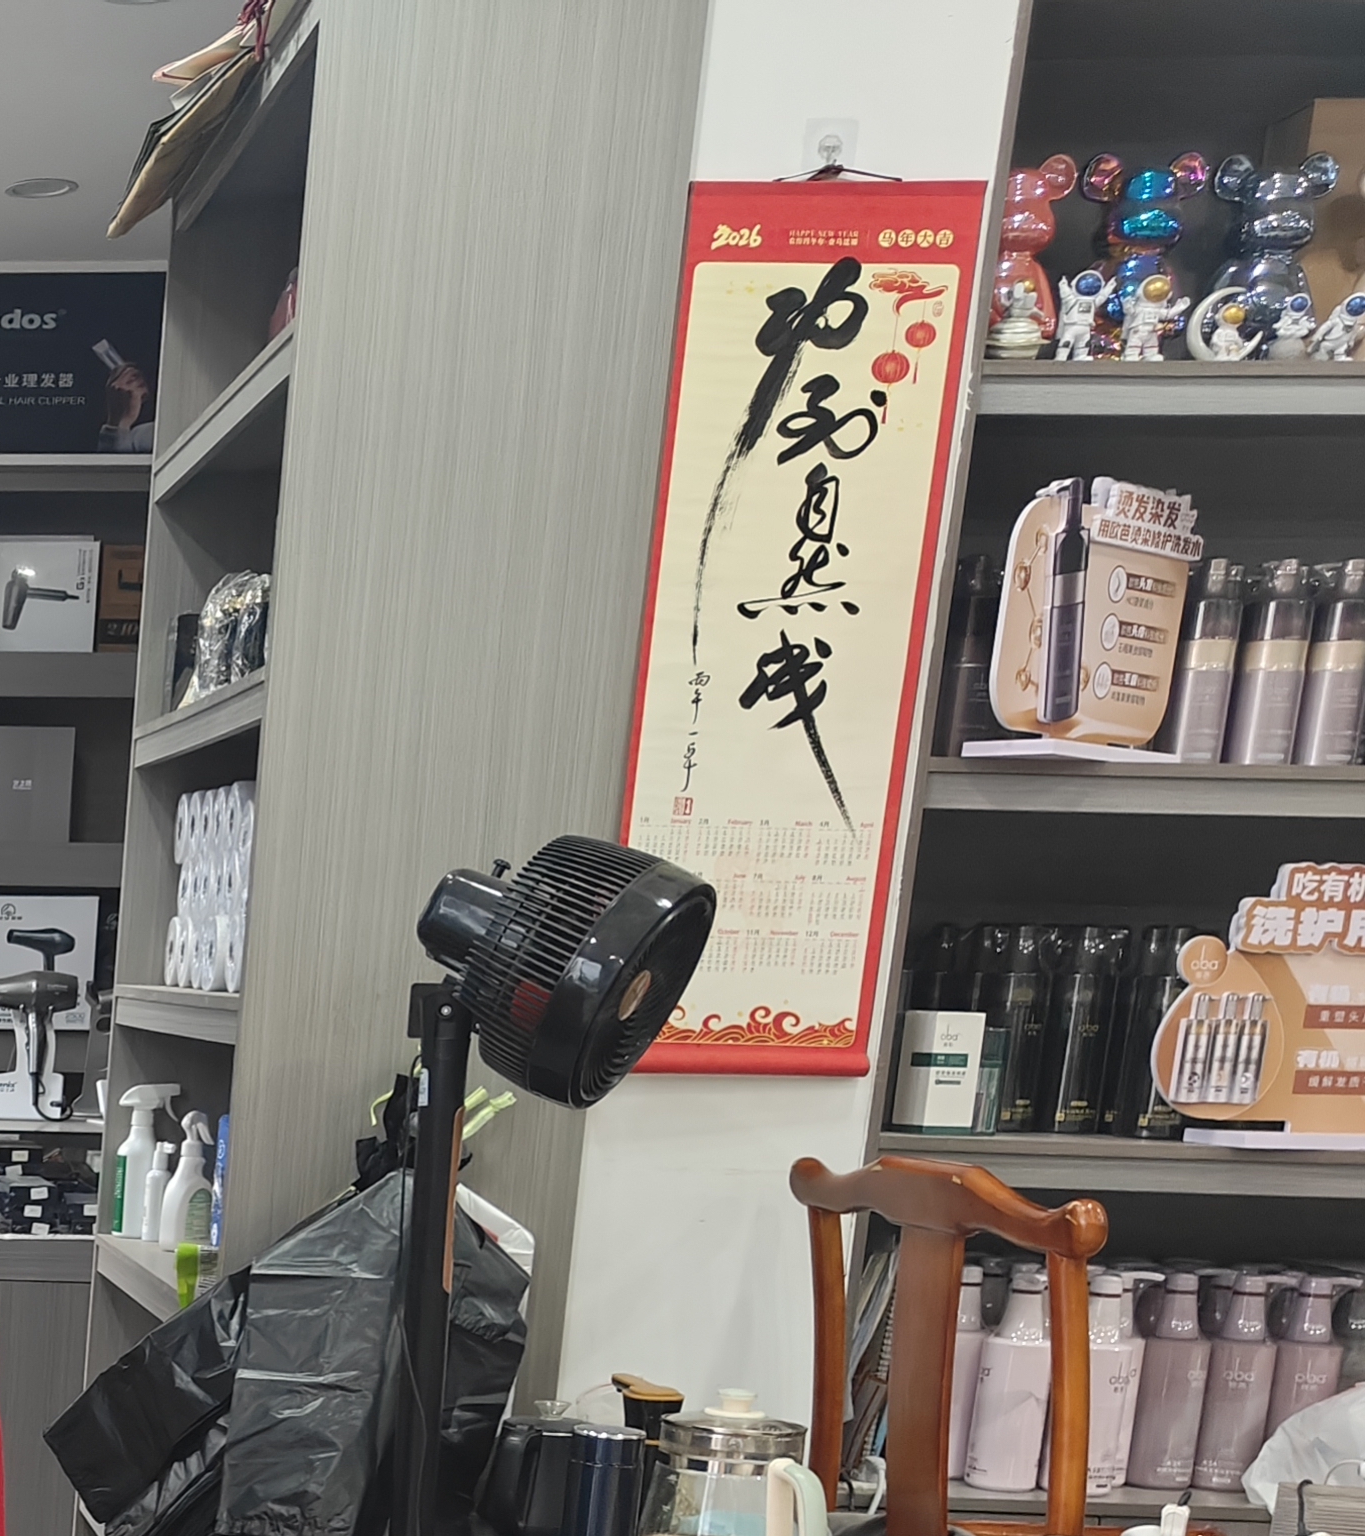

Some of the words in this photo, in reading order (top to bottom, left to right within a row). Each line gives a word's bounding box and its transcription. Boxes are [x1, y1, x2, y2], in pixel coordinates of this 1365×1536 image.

[711, 225, 762, 250] 2026
[879, 230, 953, 247] 马年大吉
[8, 396, 36, 406] HAIR
[37, 396, 86, 406] CLIPPER
[1116, 490, 1183, 530] 烫发染发
[1191, 944, 1219, 971] oba
[1307, 1075, 1365, 1089] 缓解发质
[1224, 1357, 1255, 1382] oba
[1294, 1359, 1327, 1384] oba
